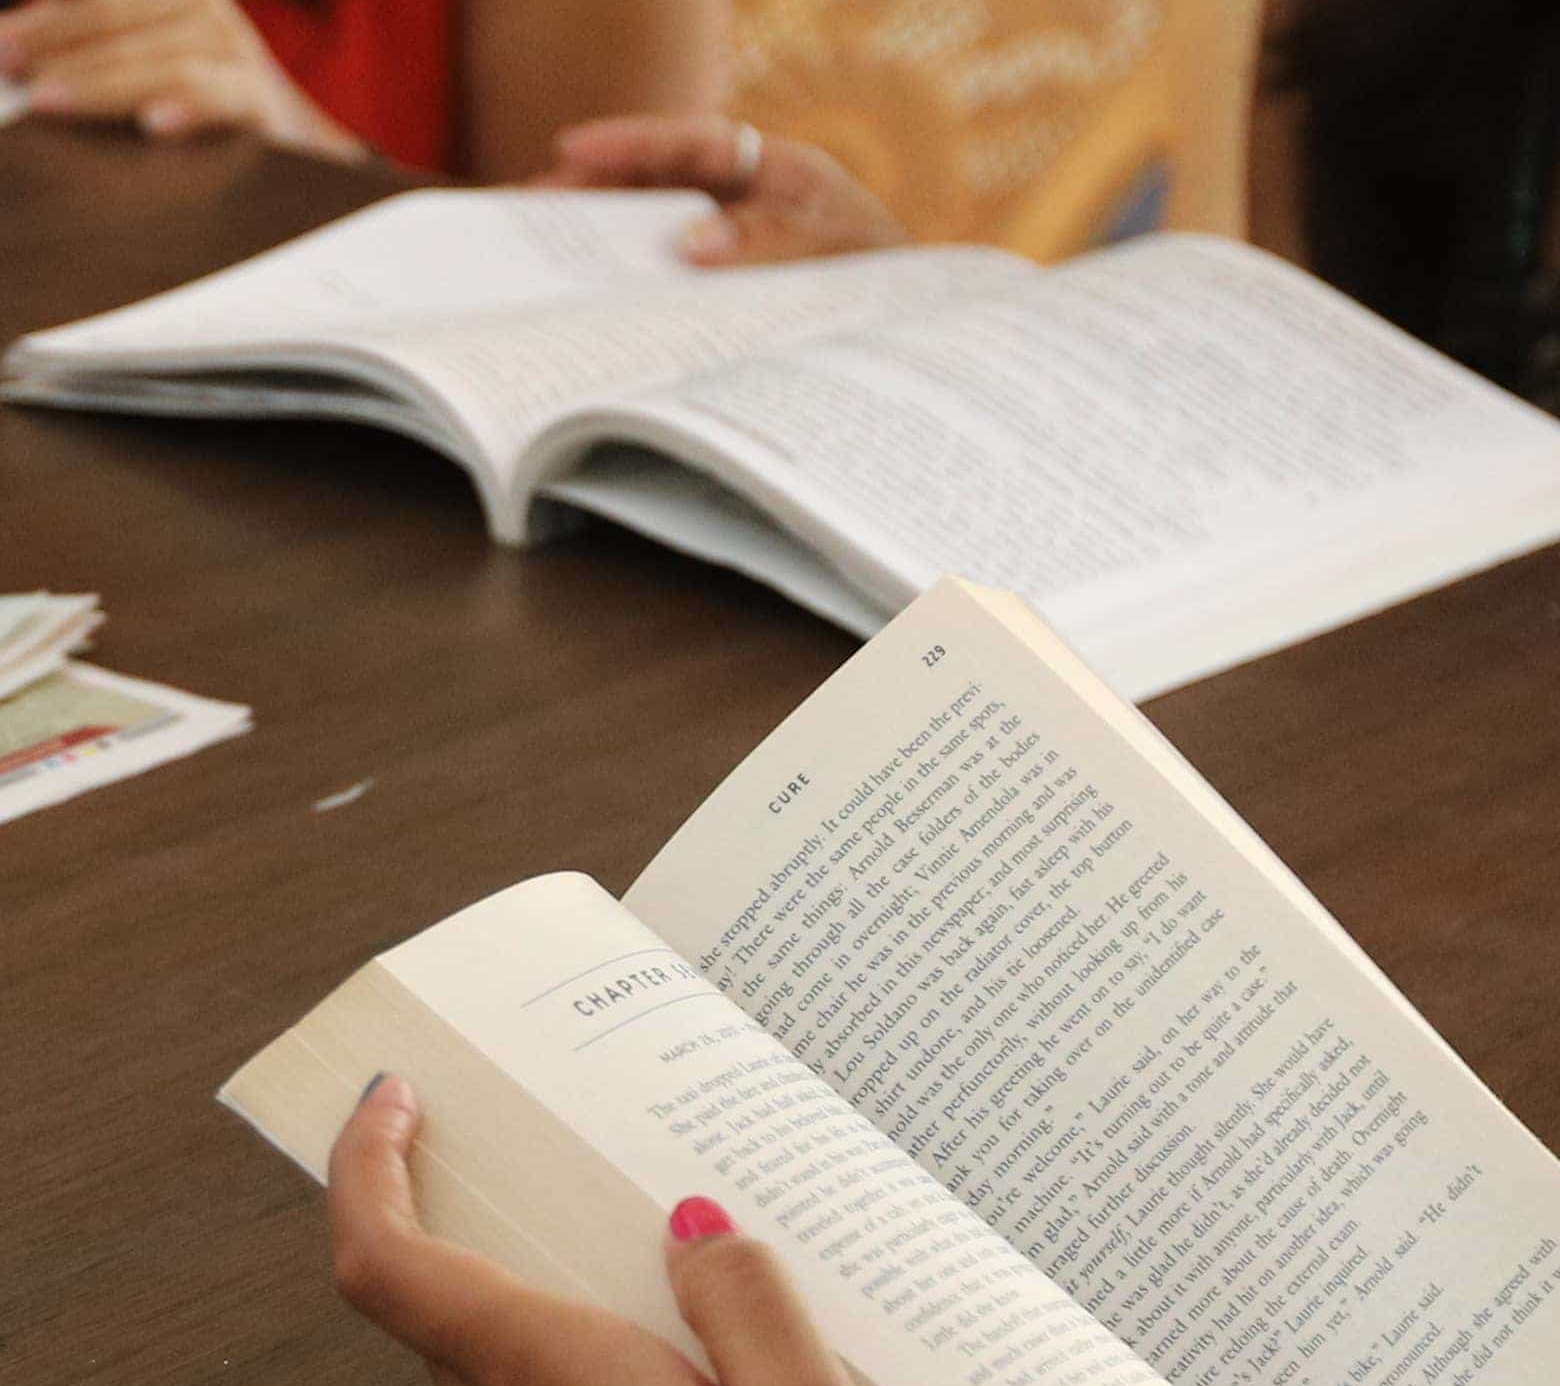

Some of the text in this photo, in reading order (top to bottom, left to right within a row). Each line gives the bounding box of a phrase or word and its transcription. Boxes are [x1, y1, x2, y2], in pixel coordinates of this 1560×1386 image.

[920, 643, 947, 669] 229
[719, 886, 772, 948] stopped
[768, 833, 827, 893] abruptly.
[819, 818, 840, 835] It
[837, 780, 876, 821] could
[867, 756, 904, 787] have
[895, 729, 933, 760] been
[927, 710, 953, 733] the
[730, 699, 1007, 967] There were the same people in the same spots,
[740, 971, 767, 999] the
[766, 931, 802, 971] same
[847, 831, 897, 882] Arnold
[891, 773, 961, 835] Besserman
[958, 750, 985, 773] was
[984, 734, 1001, 751] at
[998, 714, 1023, 736] the
[767, 771, 812, 815] CURE
[790, 921, 848, 979] through
[846, 896, 867, 921] all
[864, 875, 891, 900] the
[891, 846, 920, 875] case
[917, 805, 964, 848] folders
[963, 783, 980, 806] of
[977, 768, 1003, 791] the
[997, 731, 1042, 769] bodies
[796, 971, 834, 1013] come
[829, 952, 853, 971] in
[912, 842, 961, 882] Vinnie
[1018, 763, 1045, 786] was
[1042, 748, 1061, 766] in
[815, 765, 1079, 1030] chair he was in the previous morning and was
[573, 964, 673, 1017] CHAPTER
[823, 990, 883, 1060] absorbed
[879, 977, 900, 996] in
[894, 951, 924, 979] this
[988, 858, 1015, 889] and
[1010, 833, 1044, 866] most
[1040, 783, 1099, 838] surprising
[831, 801, 1115, 1085] Lou Soldano was back again, fast asleep with his
[873, 903, 1082, 1119] shirt undone, and his tie loosened.
[897, 819, 1134, 1052] up on the radiator cover, the top button
[914, 1080, 944, 1107] was
[939, 1055, 967, 1081] the
[963, 1025, 996, 1058] only
[992, 1001, 1020, 1029] one
[1014, 974, 1047, 1003] who
[1042, 929, 1090, 979] noticed
[1103, 892, 1131, 915] He
[1127, 850, 1171, 900] greeted
[1024, 981, 1076, 1031] without
[1070, 937, 1124, 984] looking
[1119, 919, 1141, 939] up
[1136, 890, 1171, 921] from
[1164, 872, 1189, 893] his
